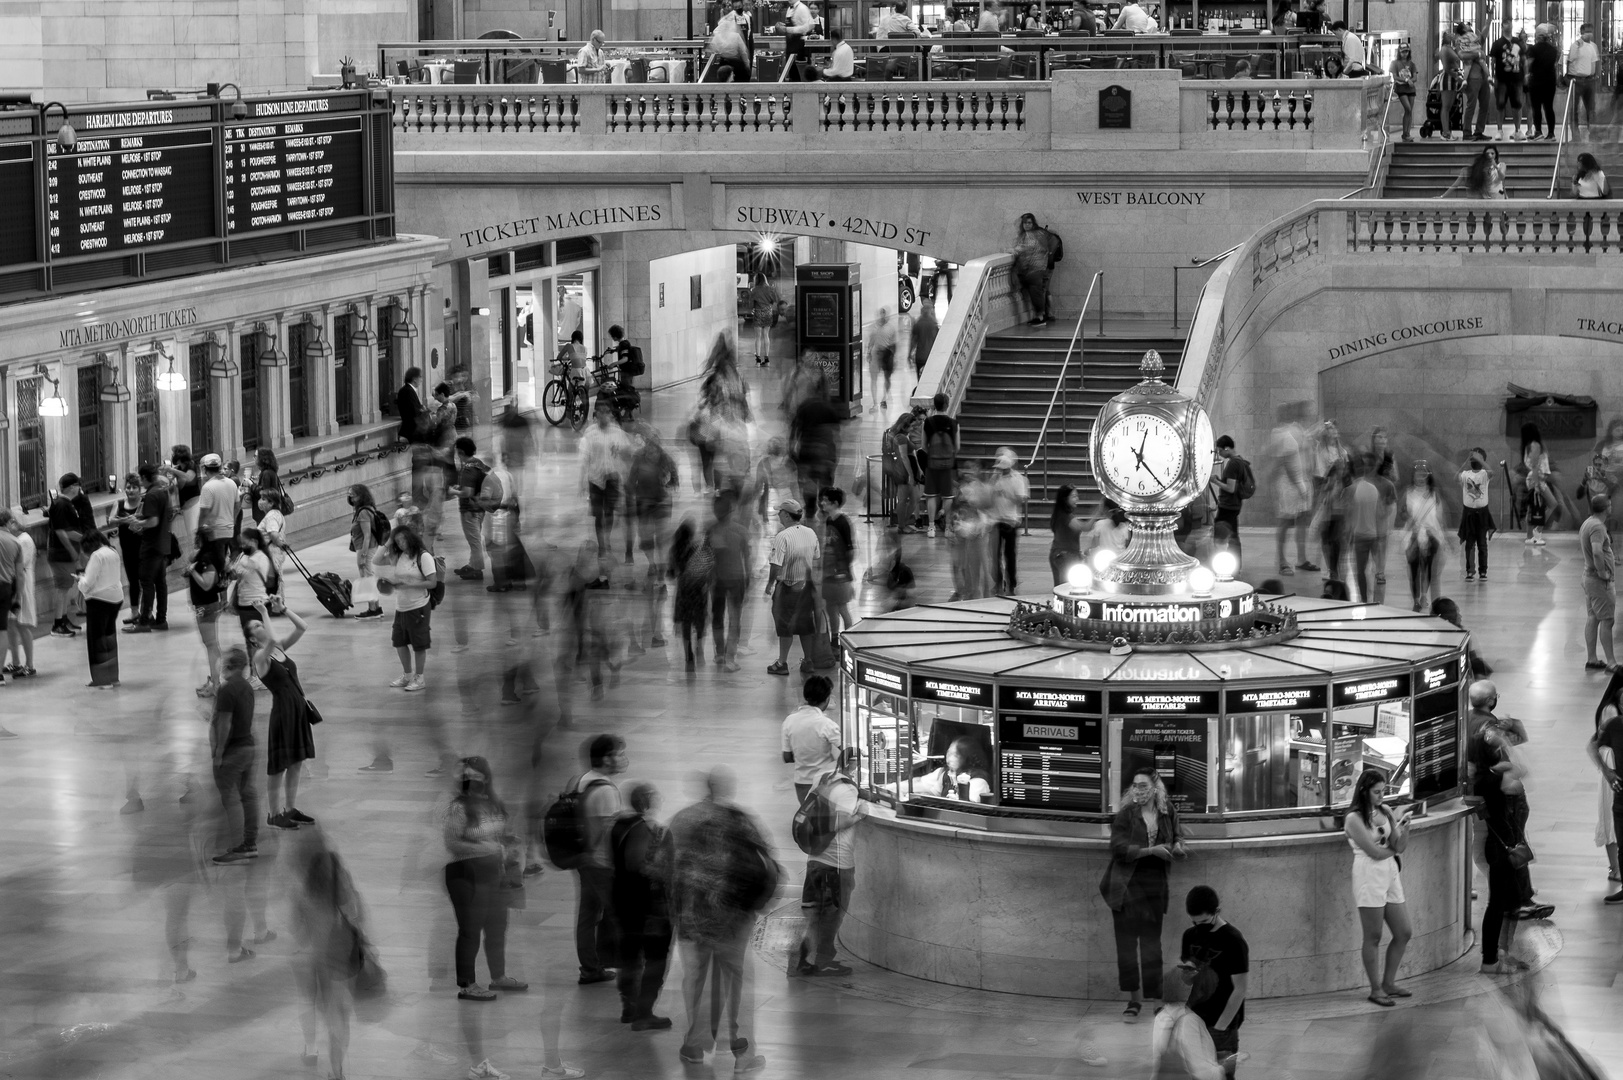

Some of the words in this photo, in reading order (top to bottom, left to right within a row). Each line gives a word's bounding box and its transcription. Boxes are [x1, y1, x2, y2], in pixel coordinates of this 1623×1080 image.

[256, 102, 279, 116] HUDSON
[281, 101, 294, 114] LINE
[295, 99, 328, 112] DEPARTURES
[86, 112, 114, 128] HARLEM
[115, 112, 131, 127] LINE
[132, 110, 172, 125] DEPARTURES
[249, 127, 276, 137] DESTINATION
[77, 140, 109, 152] DESTINATION
[323, 136, 332, 144] STOP
[83, 157, 96, 167] WHITE
[97, 156, 111, 166] PLAINS
[122, 153, 140, 163] MELROSE
[151, 152, 161, 161] STOP
[250, 155, 276, 166] POUGHKEEPSIE
[286, 153, 307, 162] TARRYTOWN
[315, 151, 324, 159] STOP
[78, 173, 103, 184] SOUTHEAST
[122, 169, 148, 180] CONNECTION
[148, 168, 154, 177] TO
[154, 166, 172, 176] WASSAIC
[324, 164, 332, 173] STOP
[324, 179, 333, 187] STOP
[79, 189, 106, 200] CRESTWOOD
[122, 185, 141, 195] MELROSE
[152, 183, 162, 192] STOP
[251, 200, 277, 211] POUGHKEEPSIE
[287, 196, 308, 206] TARRYTOWN
[316, 194, 325, 202] STOP
[1077, 192, 1121, 205] WEST
[1126, 192, 1206, 205] BALCONY
[84, 206, 97, 216] WHITE
[98, 205, 112, 214] PLAINS
[123, 201, 142, 211] MELROSE
[152, 199, 163, 208] STOP
[325, 207, 334, 216] STOP
[80, 222, 105, 233] SOUTHEAST
[123, 218, 136, 228] WHITE
[137, 216, 150, 226] PLAINS
[161, 214, 171, 223] STOP
[460, 218, 539, 247] TICKET
[545, 205, 661, 231] MACHINES
[738, 207, 825, 228] SUBWAY
[842, 216, 898, 239] 42ND
[904, 228, 930, 246] ST
[81, 238, 107, 249] CRESTWOOD
[124, 233, 143, 243] MELROSE
[153, 230, 164, 240] STOP
[59, 327, 82, 348] MTA
[84, 314, 157, 343] METRO-NORTH
[160, 307, 197, 329] TICKETS
[1329, 333, 1388, 360] DINING
[1391, 317, 1483, 340] CONCOURSE
[1123, 426, 1128, 436] 11
[1137, 421, 1145, 432] 12
[1109, 451, 1114, 462] 9
[1114, 467, 1119, 477] 8
[1164, 467, 1170, 476] 4
[1124, 476, 1129, 486] 7
[1138, 481, 1145, 490] 6
[1102, 603, 1200, 623] Information
[939, 683, 980, 695] METRO-NORTH
[1344, 686, 1357, 694] MTA
[1357, 680, 1397, 693] METRO-NORTH
[936, 690, 970, 700] TIMETABLES
[1033, 693, 1085, 701] METRO-NORTH
[1259, 690, 1310, 700] METRO-NORTH
[1355, 689, 1387, 699] TIMETABLES
[1256, 699, 1297, 707] TIMETABLES
[1026, 726, 1075, 737] ARRIVALS
